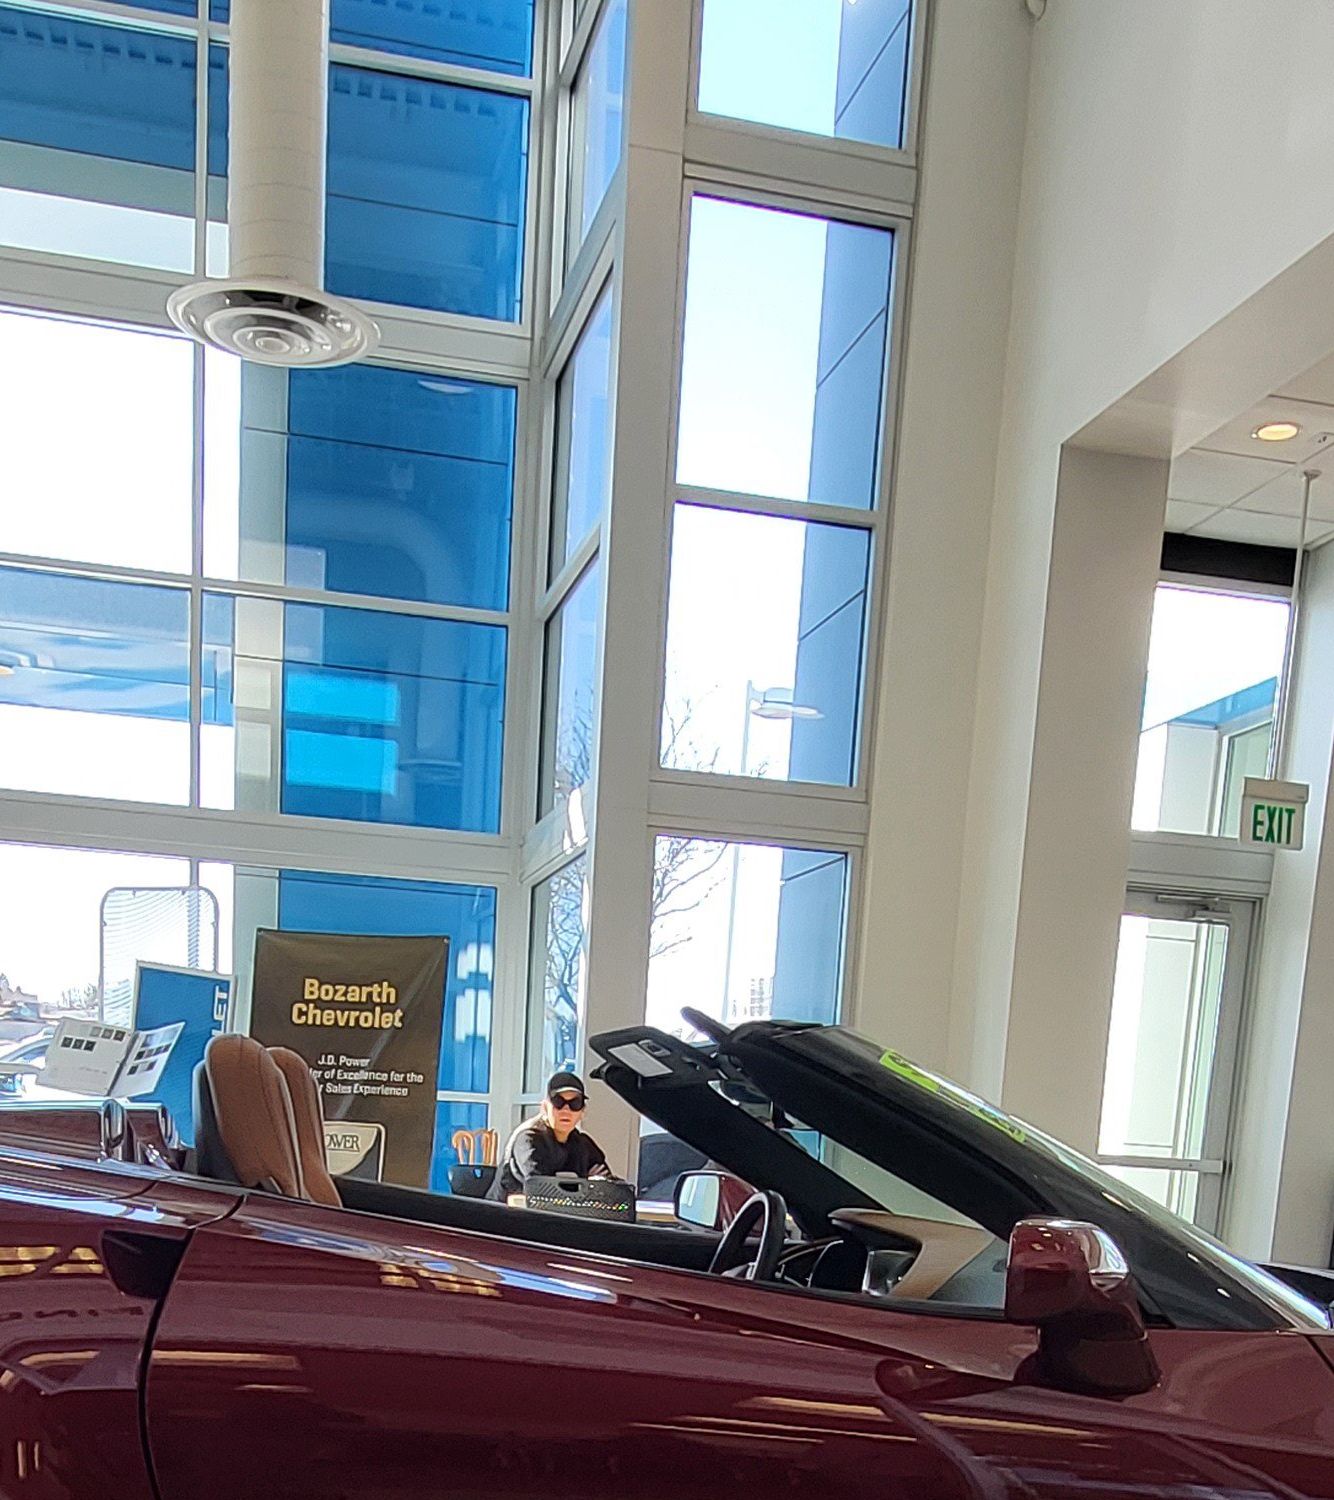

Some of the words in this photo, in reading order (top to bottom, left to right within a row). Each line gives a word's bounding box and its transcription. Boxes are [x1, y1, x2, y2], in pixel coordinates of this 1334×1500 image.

[1252, 804, 1296, 845] EXIT
[304, 978, 396, 1003] Bozarth
[292, 1003, 403, 1028] Chevrolet
[318, 1055, 337, 1065] J.D.
[339, 1055, 371, 1067] Power
[324, 1068, 335, 1078] of
[337, 1069, 388, 1081] Excellence
[390, 1071, 405, 1082] for
[406, 1072, 424, 1083] the
[325, 1082, 352, 1094] Sales
[354, 1083, 408, 1096] Experience
[325, 1134, 360, 1152] OWER
